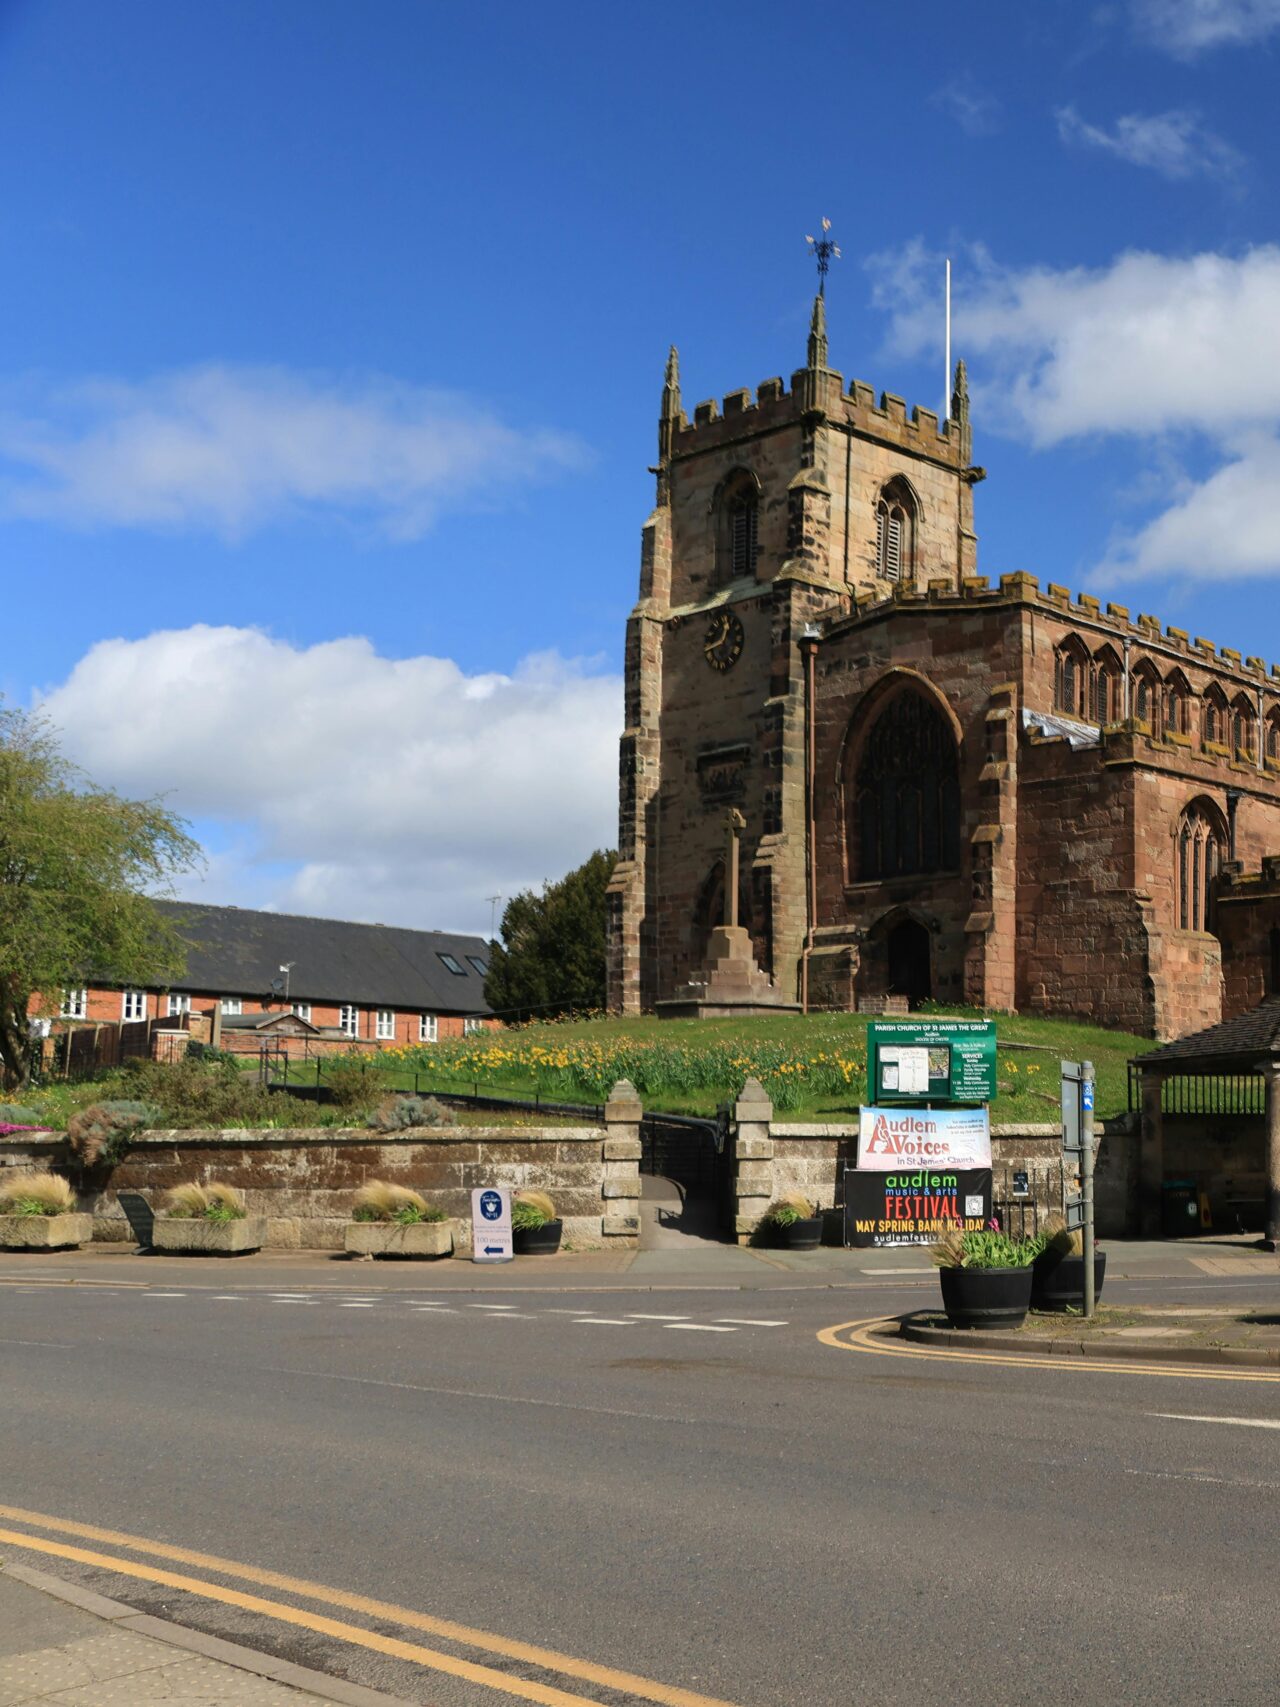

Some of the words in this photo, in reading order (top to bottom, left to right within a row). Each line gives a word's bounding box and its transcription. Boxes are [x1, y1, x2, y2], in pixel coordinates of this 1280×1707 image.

[866, 1114, 936, 1153] Audlem
[891, 1135, 950, 1155] Voices
[907, 1157, 916, 1165] St
[886, 1170, 957, 1187] audlem
[936, 1188, 957, 1196] arts
[886, 1196, 960, 1219] FESTIVAL
[856, 1220, 875, 1232] MAY
[878, 1220, 915, 1232] SPRING
[919, 1220, 944, 1232] BANK
